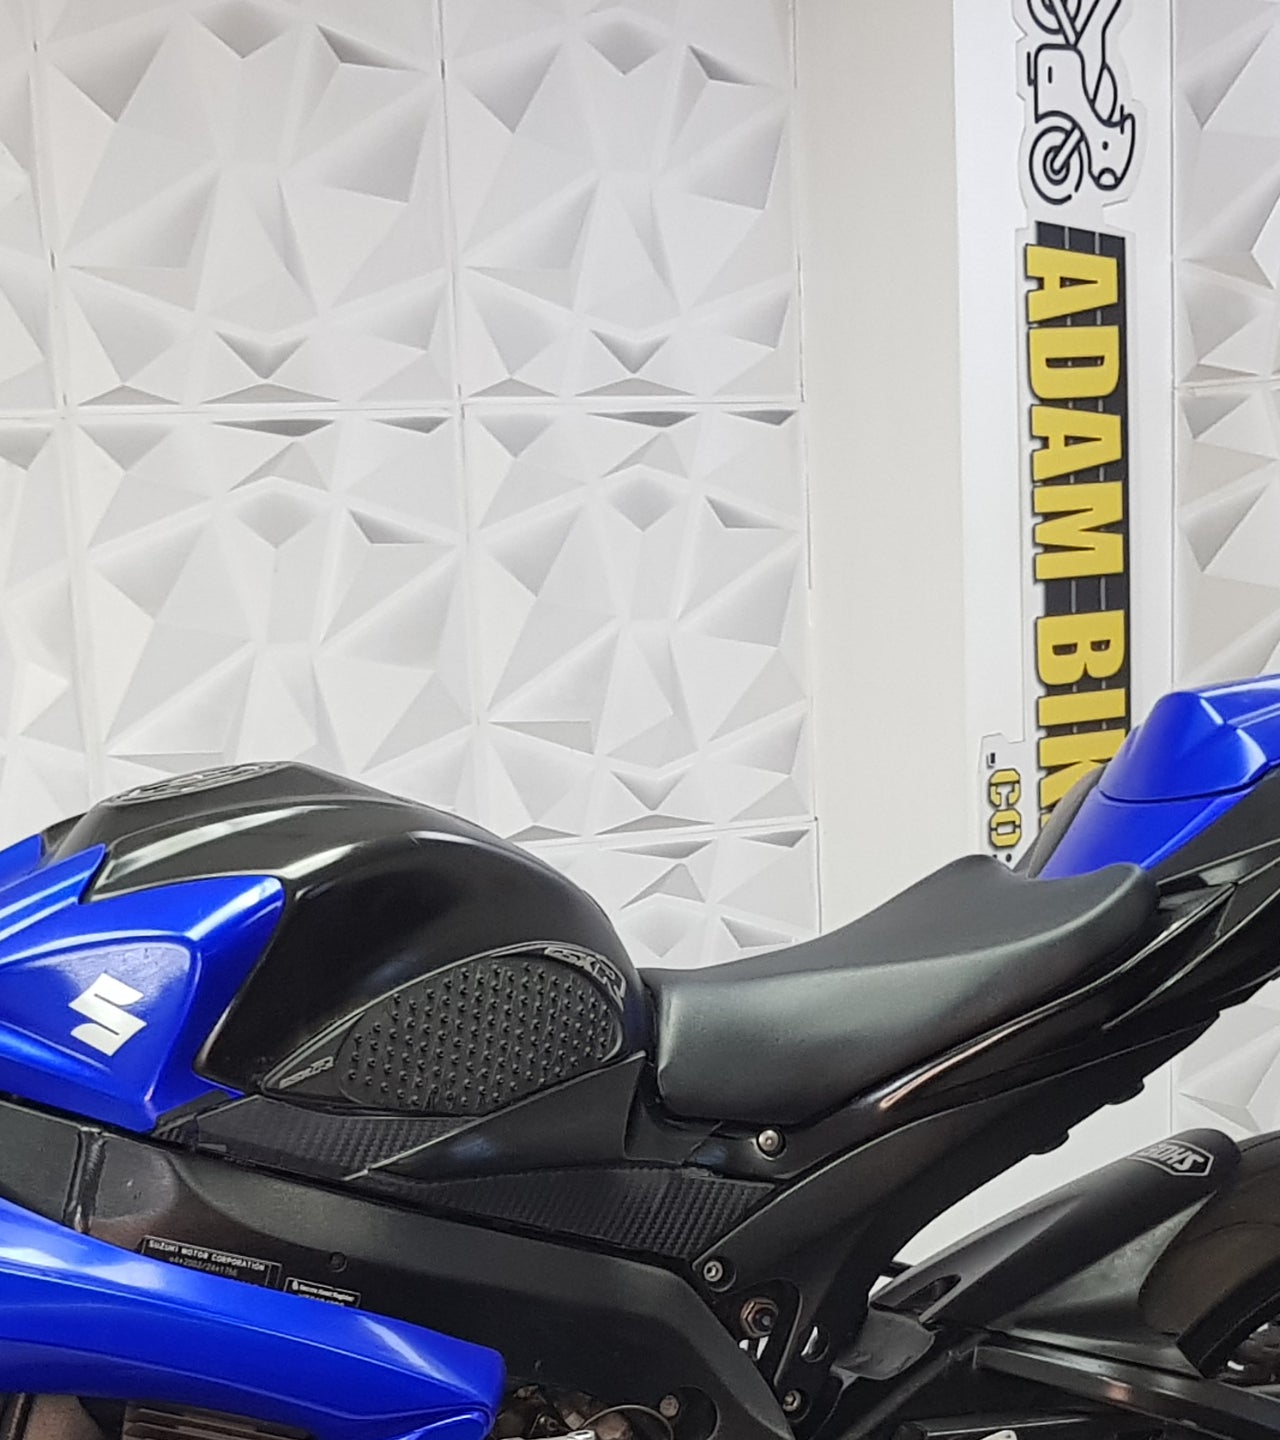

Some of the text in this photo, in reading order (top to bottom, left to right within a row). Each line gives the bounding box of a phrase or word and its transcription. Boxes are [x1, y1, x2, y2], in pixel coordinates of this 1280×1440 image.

[1025, 243, 1129, 832] ADAM BIK
[181, 1248, 209, 1260] MOTOR
[211, 1254, 266, 1271] CORPORATION
